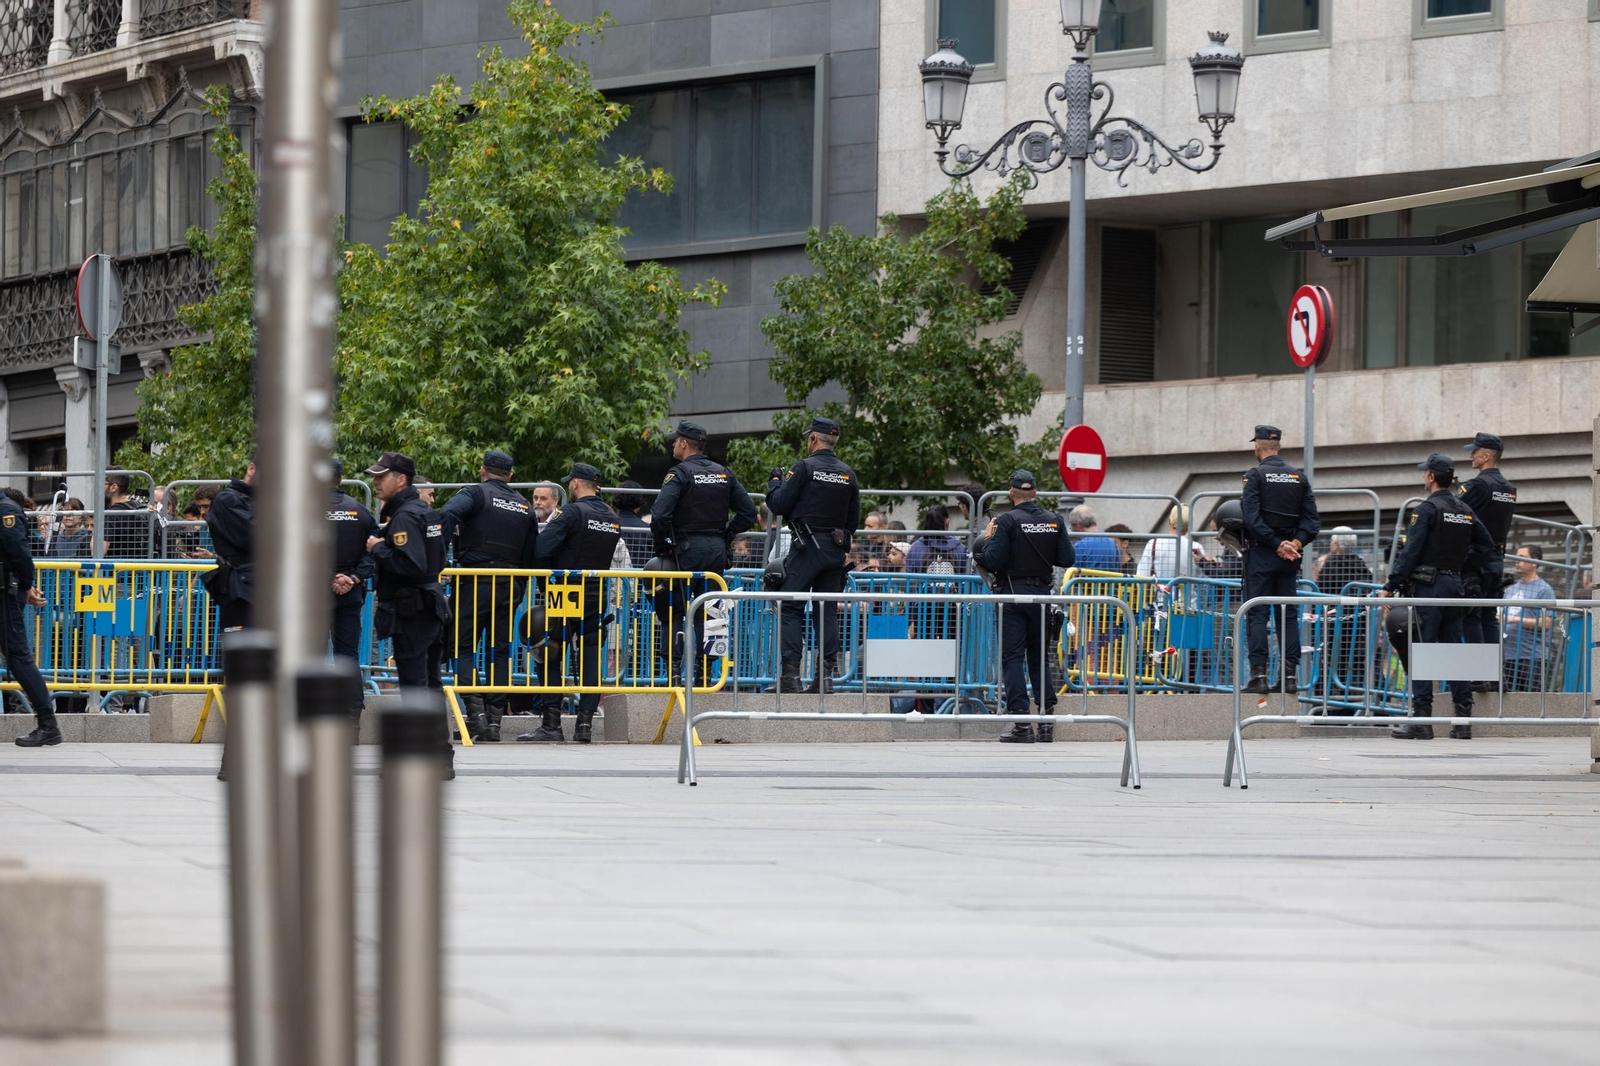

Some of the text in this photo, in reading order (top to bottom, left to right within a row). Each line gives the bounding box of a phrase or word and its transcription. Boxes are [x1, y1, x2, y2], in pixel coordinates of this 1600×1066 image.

[813, 475, 850, 485] NACIONAL
[492, 502, 529, 515] NACIONAL
[588, 524, 620, 535] NACIONAL
